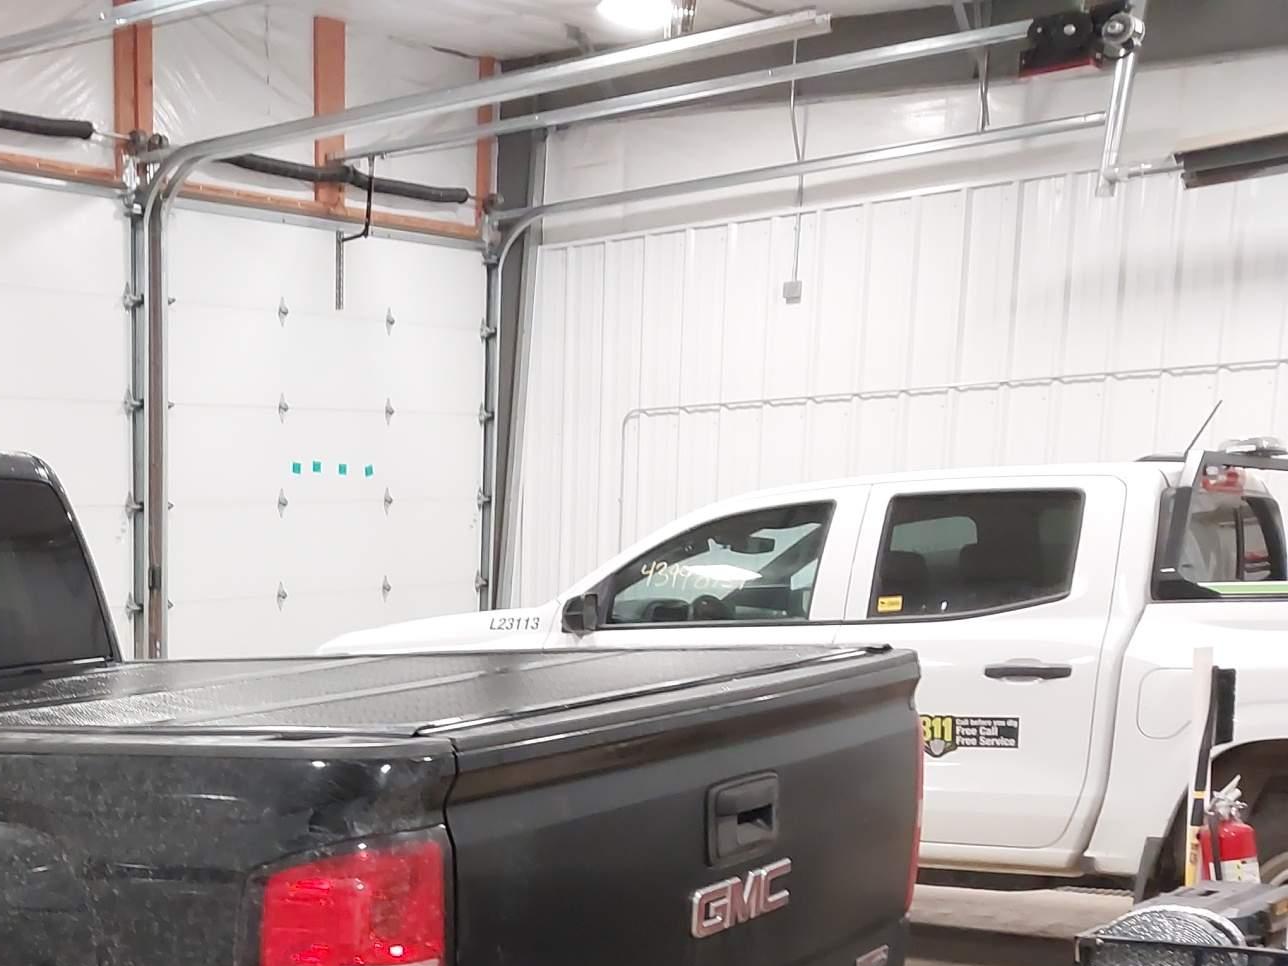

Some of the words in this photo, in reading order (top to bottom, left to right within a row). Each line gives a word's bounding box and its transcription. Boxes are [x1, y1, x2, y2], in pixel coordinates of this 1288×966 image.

[489, 617, 540, 631] L23113
[955, 726, 977, 736] Free
[955, 735, 977, 746] Free
[692, 858, 792, 938] GMC
